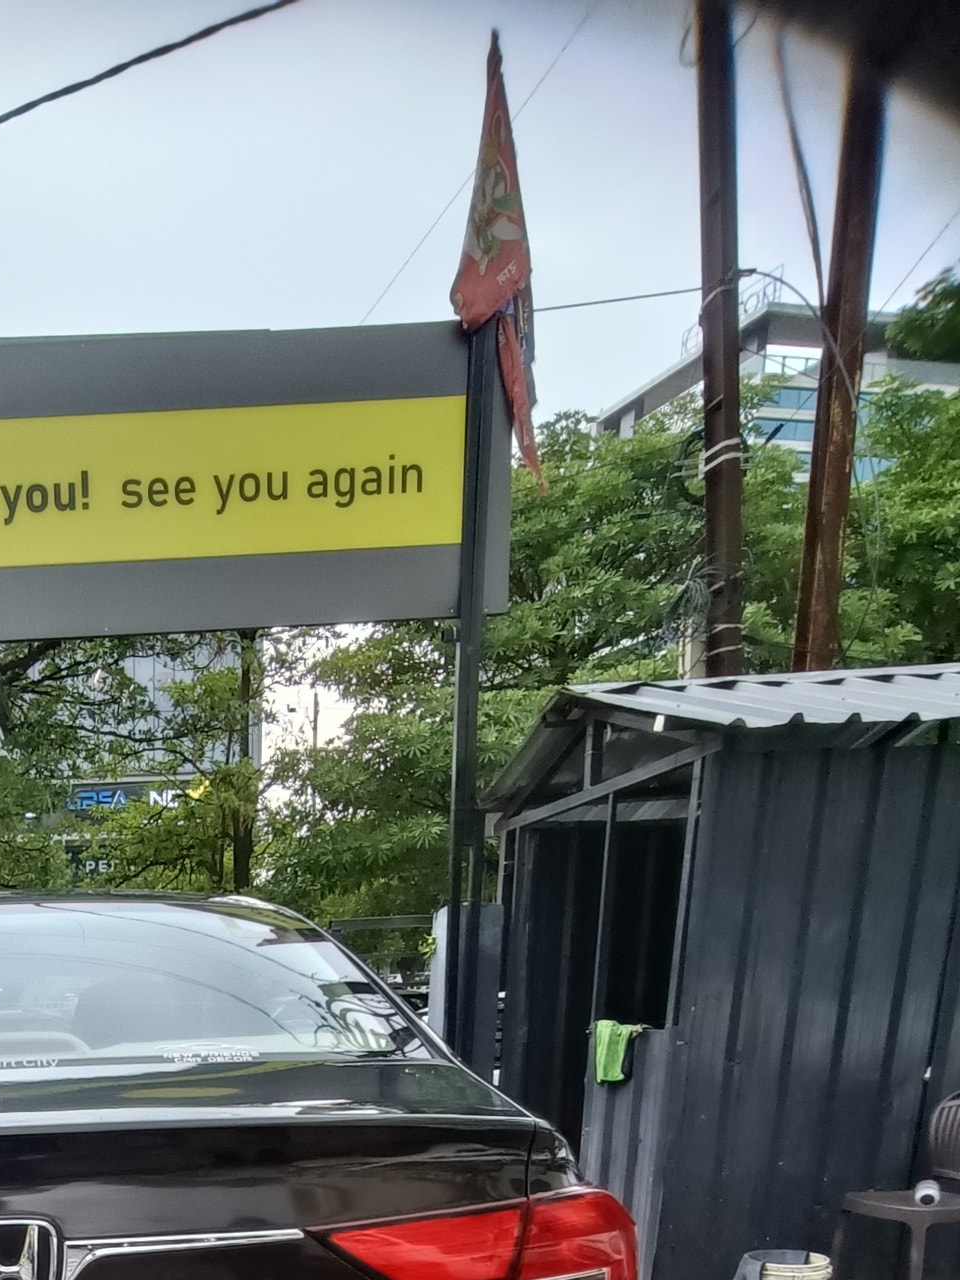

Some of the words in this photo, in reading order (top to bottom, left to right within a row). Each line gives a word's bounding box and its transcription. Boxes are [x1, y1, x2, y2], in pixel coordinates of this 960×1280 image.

[2, 470, 92, 525] you!
[120, 474, 197, 509] see
[213, 470, 290, 515] you
[306, 455, 425, 509] again
[23, 1056, 59, 1068] City
